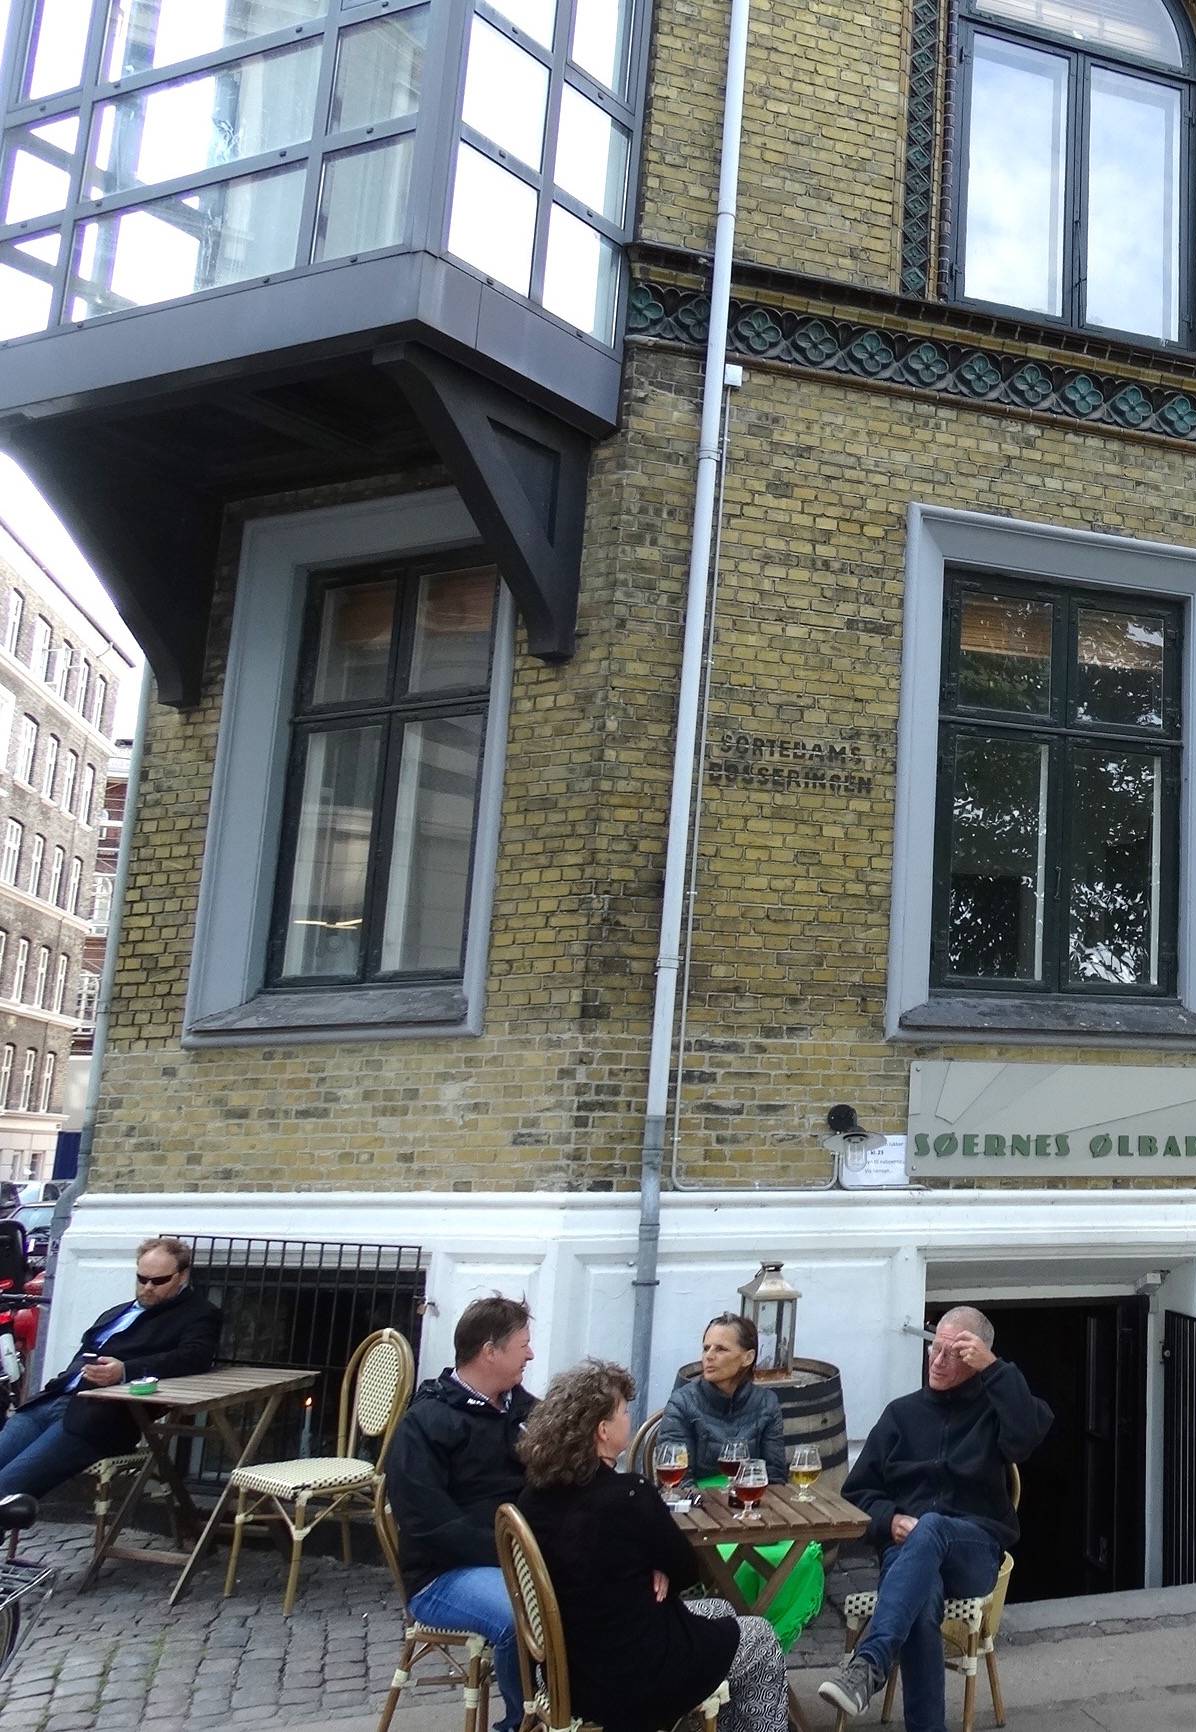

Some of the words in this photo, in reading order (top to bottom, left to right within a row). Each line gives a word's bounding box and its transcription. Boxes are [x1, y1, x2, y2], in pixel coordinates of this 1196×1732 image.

[720, 734, 862, 765] SORTEDAMS
[709, 761, 873, 794] DOSSERINGEN
[914, 1132, 1070, 1158] SØERNES
